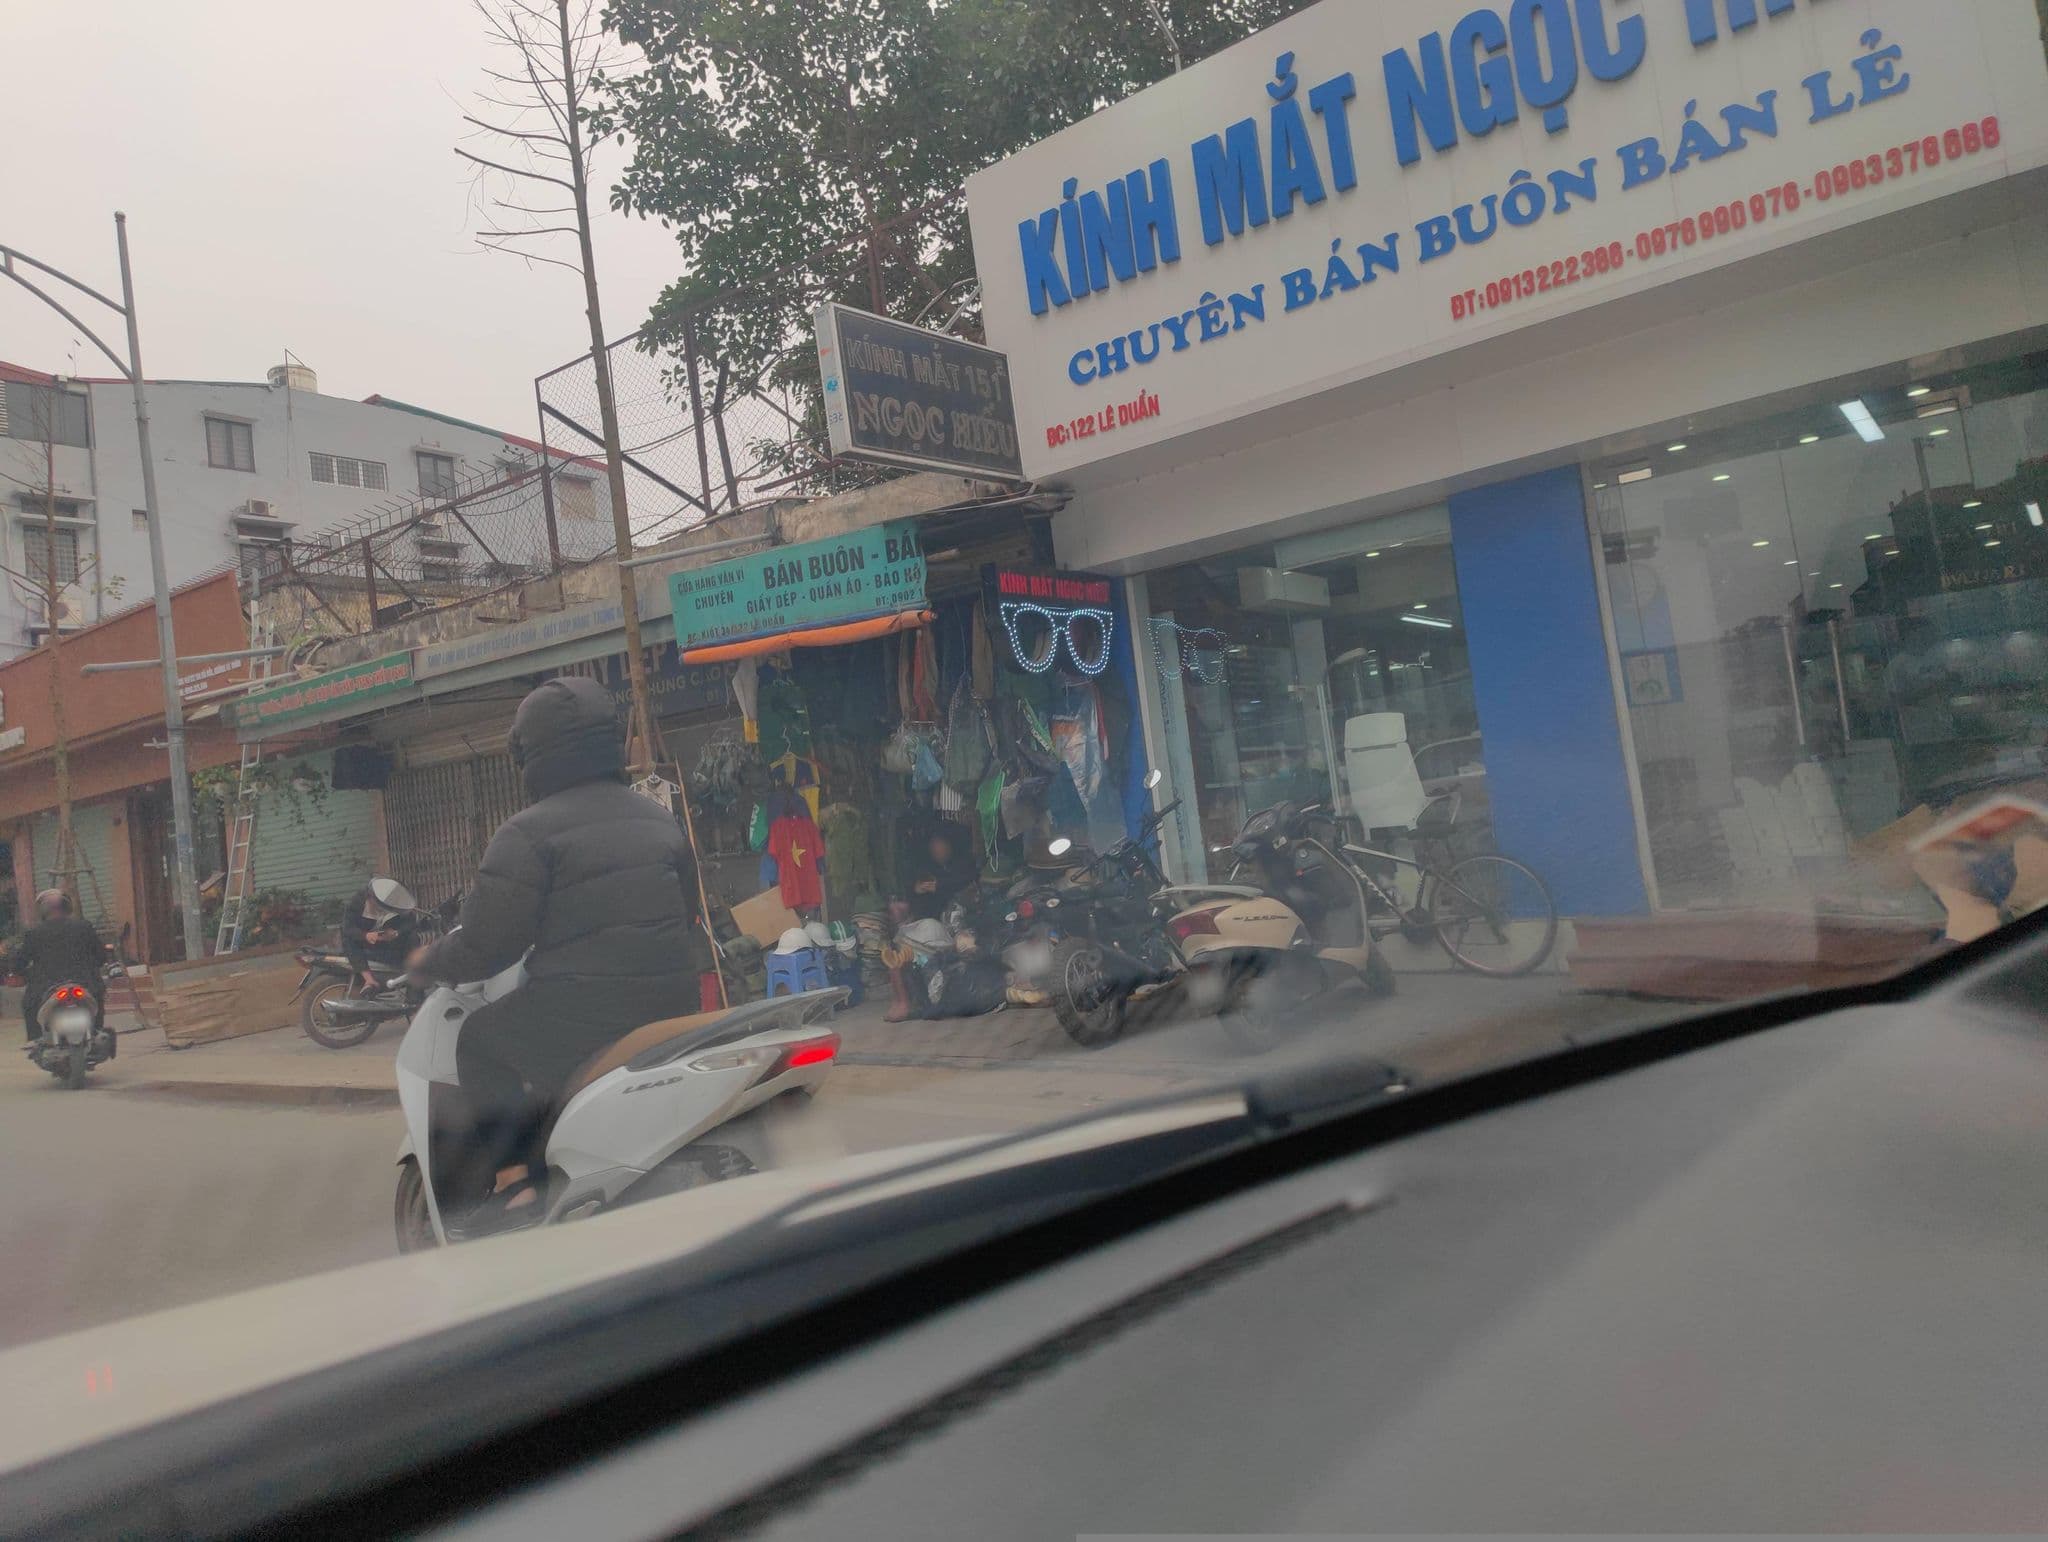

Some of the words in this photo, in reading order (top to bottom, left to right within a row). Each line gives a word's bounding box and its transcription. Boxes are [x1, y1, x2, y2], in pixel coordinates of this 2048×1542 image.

[1018, 177, 1181, 317] KÍNH
[1191, 50, 1358, 247] MẮT
[1067, 283, 1267, 387] CHUYÊN
[1281, 232, 1401, 313] BÁN
[1415, 157, 1598, 264] BUÔN
[1616, 89, 1779, 191] BÁN
[1801, 28, 1911, 125] LẺ
[846, 333, 908, 380] KÍNH
[912, 343, 960, 392] MẮT
[853, 391, 946, 451] NGỌC
[1097, 404, 1116, 433] LÊ
[763, 558, 804, 590] BÁN
[807, 544, 865, 580] BUÔN
[694, 589, 735, 611] CHUYÊN
